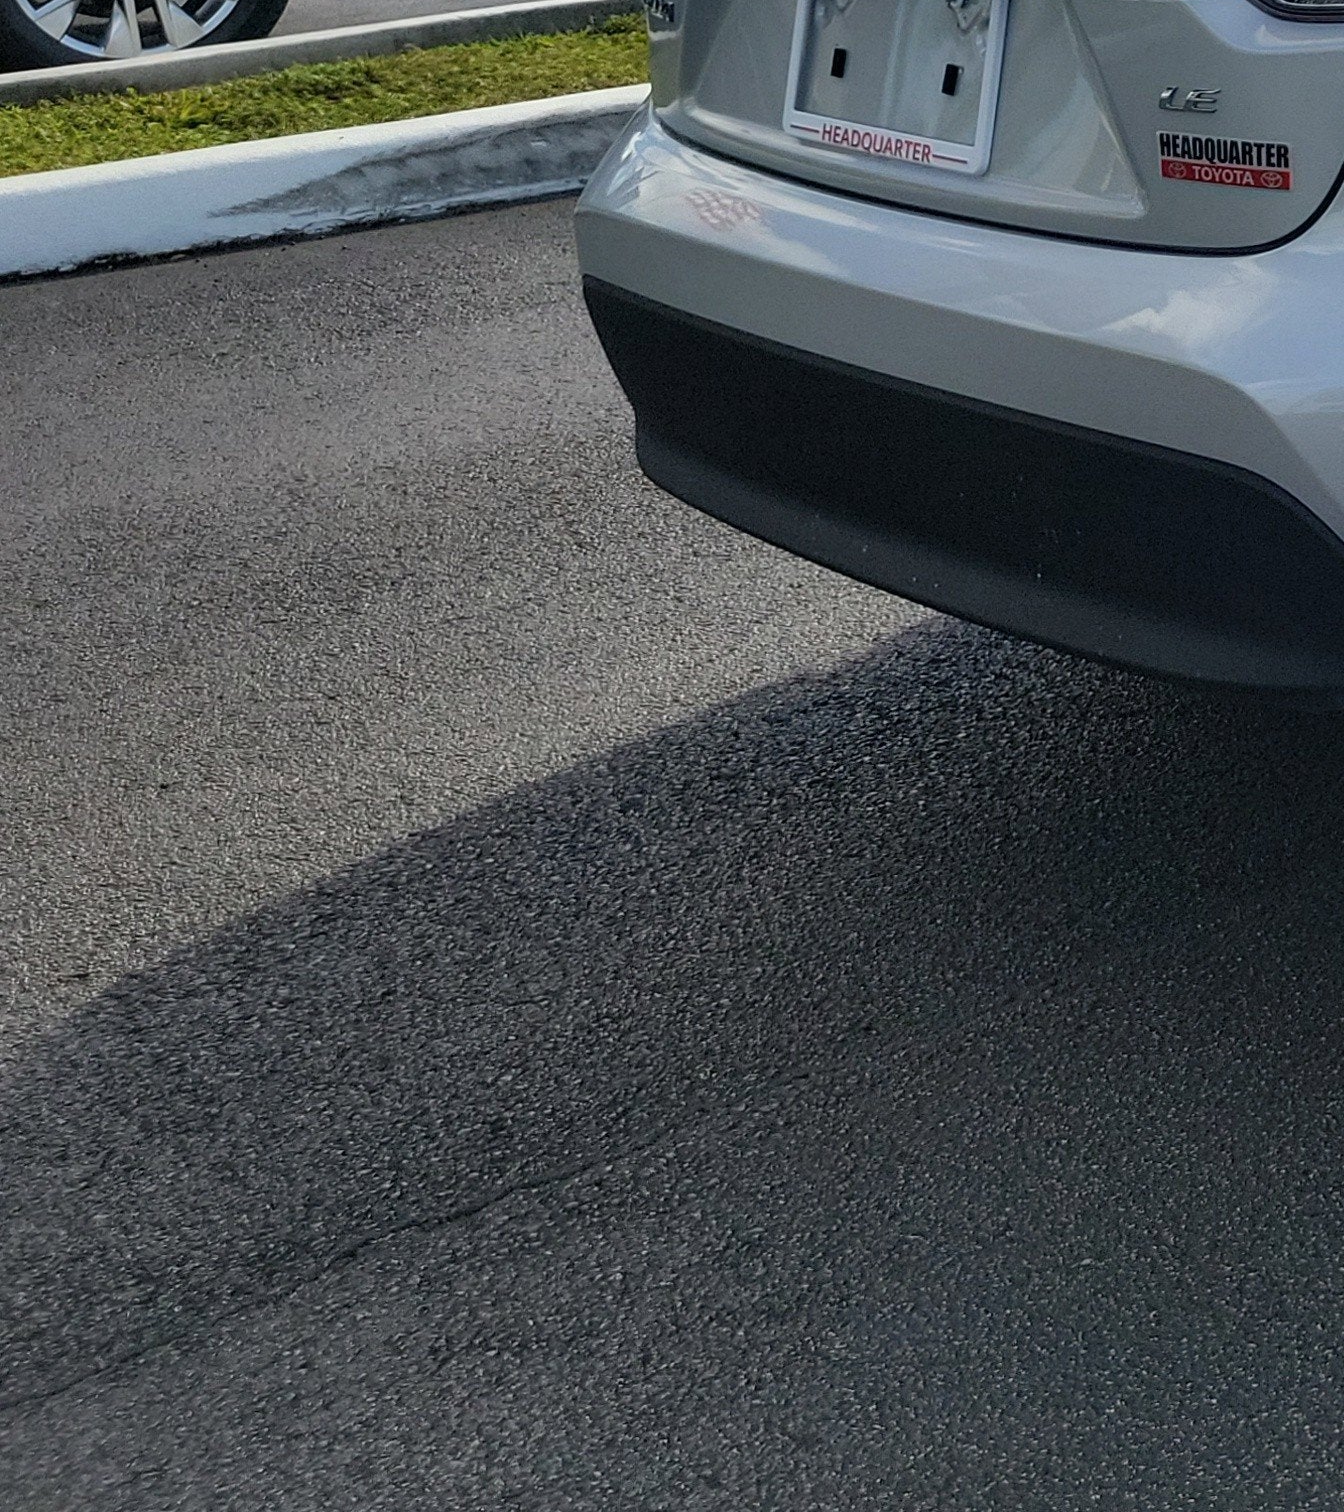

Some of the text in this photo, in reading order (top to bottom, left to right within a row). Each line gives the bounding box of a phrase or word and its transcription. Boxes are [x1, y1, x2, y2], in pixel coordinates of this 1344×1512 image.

[1159, 87, 1221, 113] LE
[822, 123, 932, 164] HEADQUARTER
[1159, 133, 1290, 169] HEADQUARTER
[1192, 165, 1255, 186] TOYOTA
